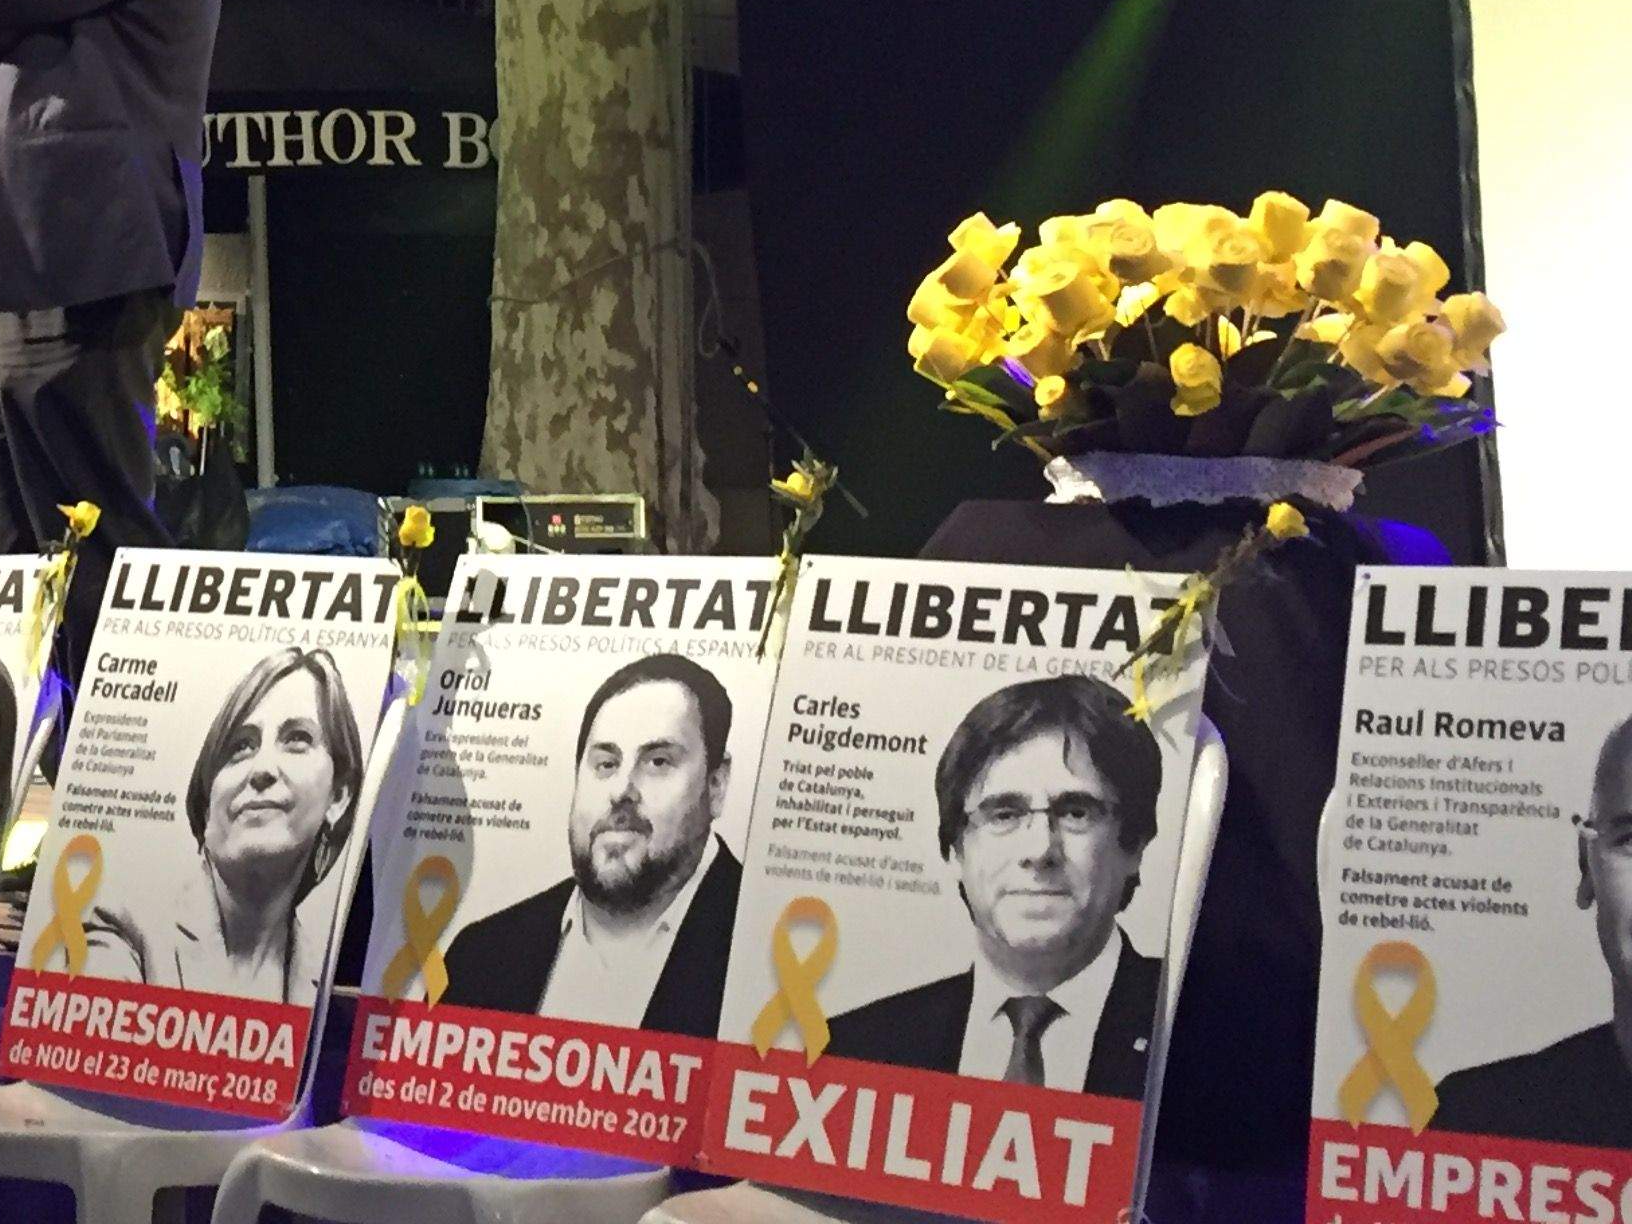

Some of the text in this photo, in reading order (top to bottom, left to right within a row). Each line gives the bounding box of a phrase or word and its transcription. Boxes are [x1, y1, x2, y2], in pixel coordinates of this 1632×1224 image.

[110, 563, 400, 623] LLIBERTAT
[455, 575, 773, 631] LLIBERTAT
[102, 617, 389, 649] PER ALS PRESOS POLÍTICS A ESPANYA
[446, 631, 477, 648] PER
[517, 633, 581, 652] PRESOS
[586, 635, 662, 655] POLÍTICS
[667, 639, 679, 656] A
[96, 652, 158, 676] Carme
[803, 640, 837, 659] PER
[842, 642, 864, 661] AL
[871, 644, 976, 668] PRESIDENT
[982, 652, 1008, 671] DE
[1015, 655, 1037, 673] LA
[438, 667, 491, 690] Oriol
[1358, 654, 1632, 686] PER ALS PRESOS POL
[90, 676, 178, 702] Forcadell
[430, 694, 542, 723] Junqueras
[792, 693, 861, 719] Carles
[1354, 707, 1565, 742] Raul Romeva
[510, 735, 529, 748] del
[787, 722, 928, 756] Puigdemont
[459, 749, 473, 761] de
[474, 750, 485, 762] la
[486, 750, 549, 766] Generalitat
[782, 759, 874, 781] Triat pel poble
[1350, 751, 1513, 773] Exconseller d'Afers i
[65, 782, 177, 805] Falsament acusada de
[778, 778, 865, 800] de Catalunya,
[1348, 772, 1543, 796] Relacions Institucionals
[61, 801, 175, 821] cometre actes violents
[410, 791, 523, 812] Falsament acusat de
[775, 795, 914, 823] inhabilitat i perseguit
[1356, 793, 1429, 811] Exteriors
[1443, 798, 1560, 819] Transparència
[57, 815, 71, 828] de
[405, 810, 530, 830] cometre actes violents
[771, 816, 792, 829] per
[796, 816, 837, 834] l'Estat
[1344, 813, 1478, 836] de la Generalitat
[767, 843, 924, 873] Falsament acusat d'actes
[1342, 834, 1452, 857] de Catalunya.
[764, 864, 812, 881] violents
[814, 868, 831, 882] de
[1341, 867, 1512, 893] Falsament acusat de
[1339, 890, 1528, 917] cometre actes violents
[1338, 909, 1358, 926] de
[9, 986, 296, 1067] EMPRESONADA
[7, 1038, 278, 1104] de NOU el 23 de març 2018
[361, 1014, 702, 1103] EMPRESONAT
[357, 1070, 687, 1143] des del 2 de novembre 2017
[724, 1070, 1113, 1206] EXILIAT
